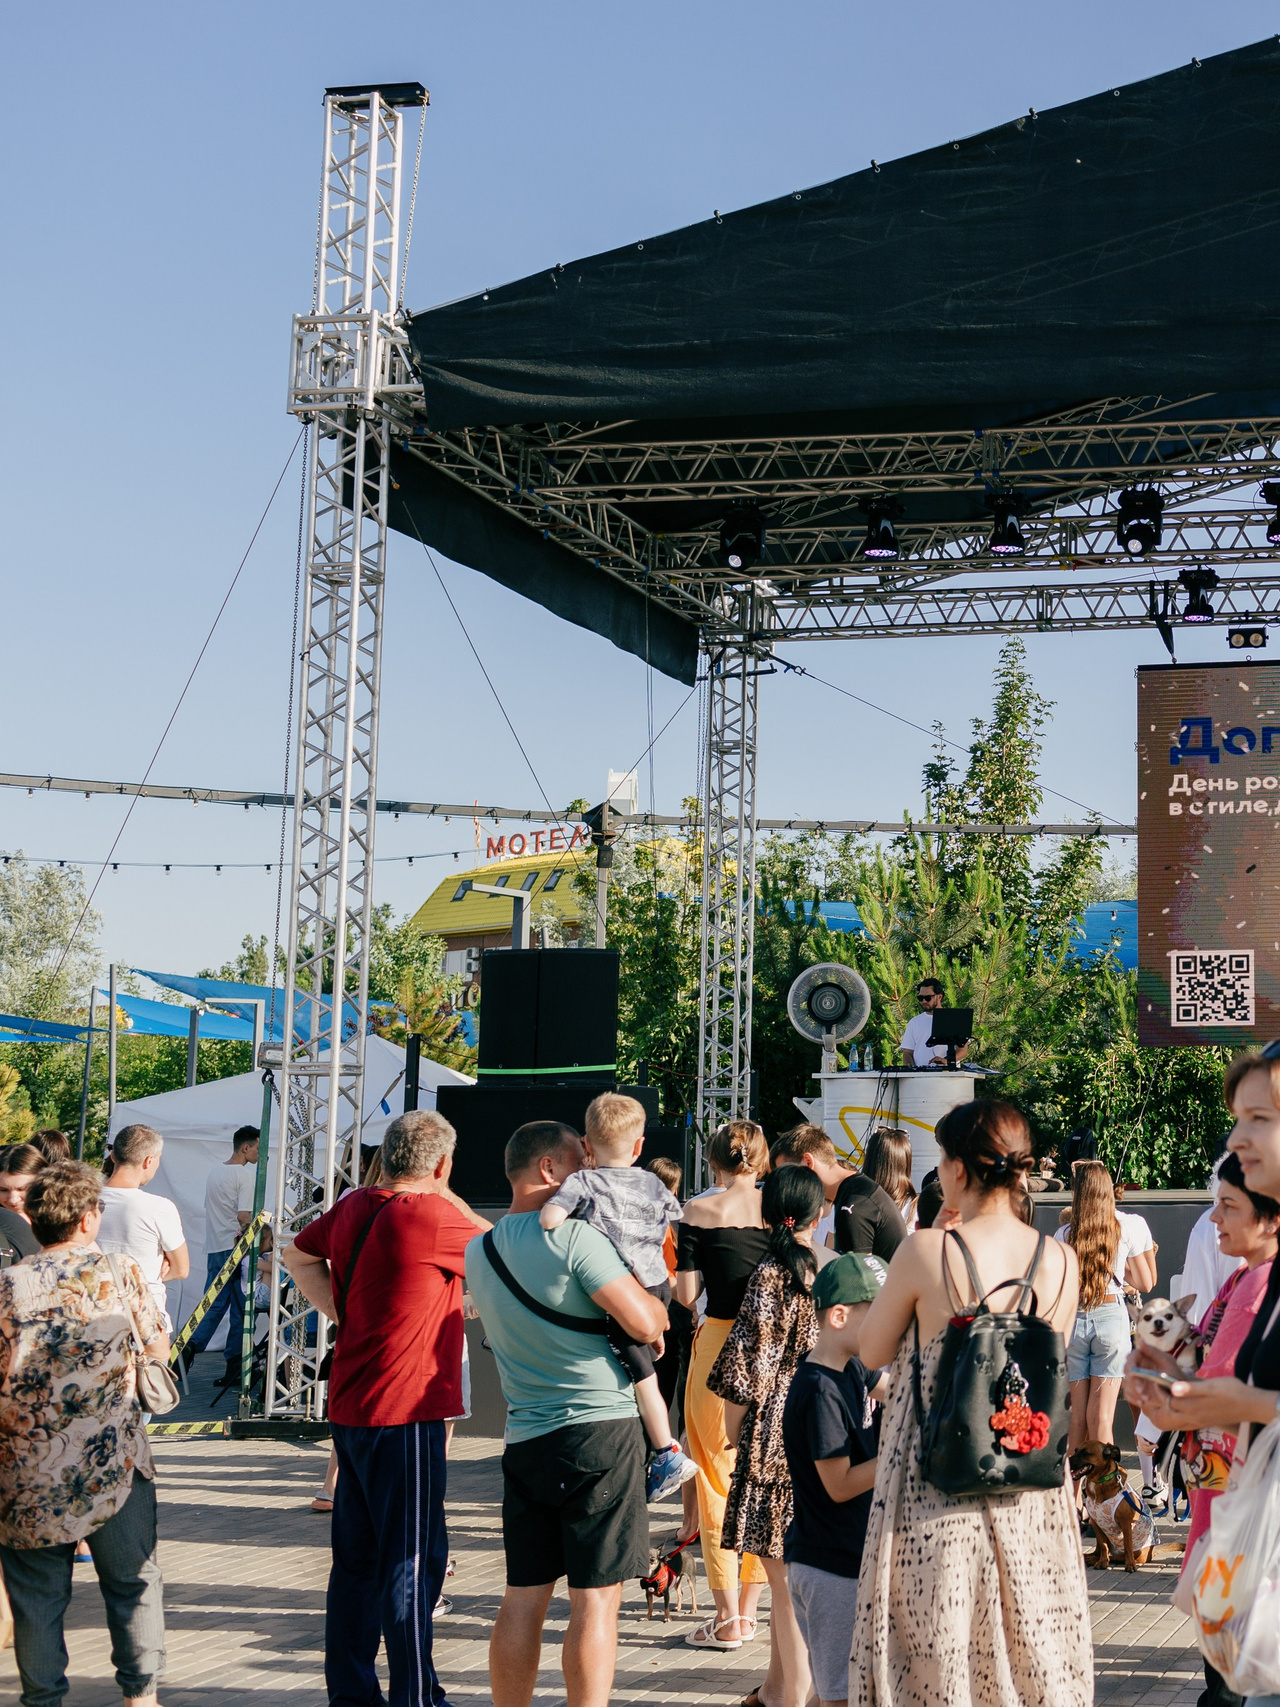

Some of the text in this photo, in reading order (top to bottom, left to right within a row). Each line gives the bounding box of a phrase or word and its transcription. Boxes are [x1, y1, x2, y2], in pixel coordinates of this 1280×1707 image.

[1168, 774, 1239, 796] День
[1169, 803, 1183, 815] в
[486, 824, 595, 859] МОТЕЛ
[863, 1256, 883, 1271] NEW
